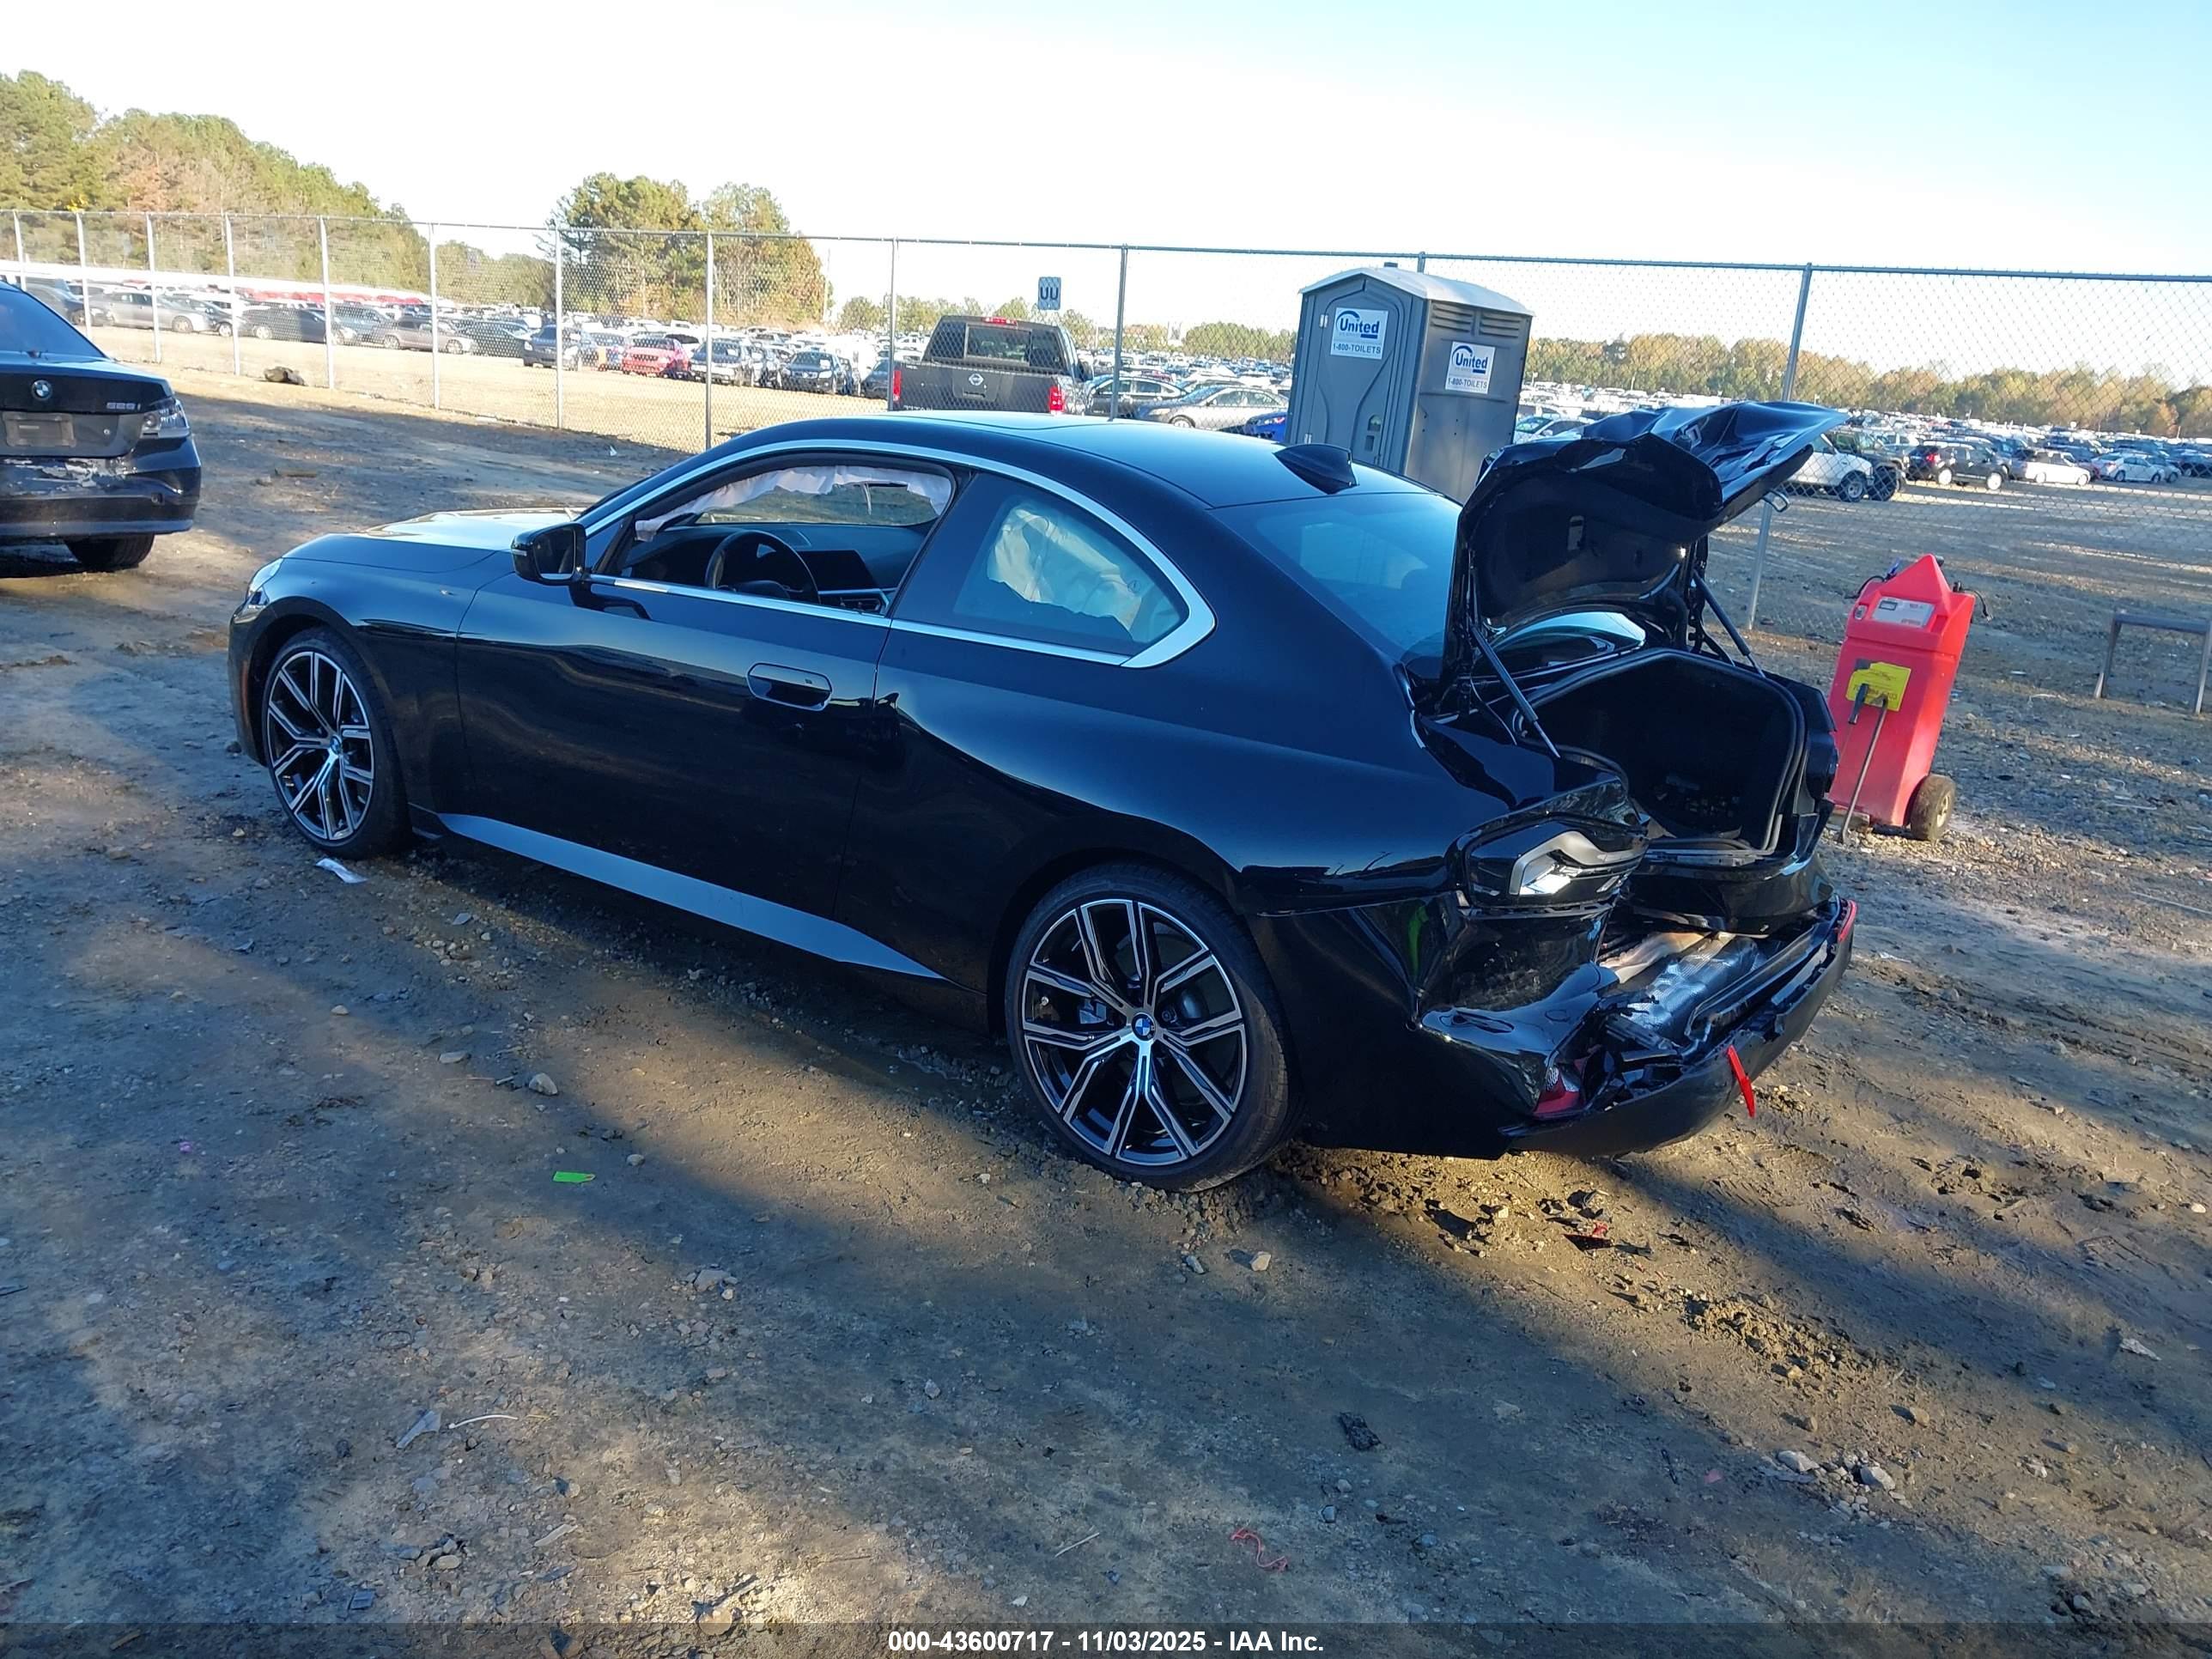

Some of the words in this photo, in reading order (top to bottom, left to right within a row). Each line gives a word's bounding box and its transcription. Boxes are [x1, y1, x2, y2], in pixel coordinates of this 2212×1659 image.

[1040, 286, 1059, 301] UU
[1340, 318, 1380, 334] United
[1333, 343, 1382, 354] 1-800-TOILETS
[1455, 352, 1488, 369] United
[1448, 377, 1487, 389] 1-800-TOILETS
